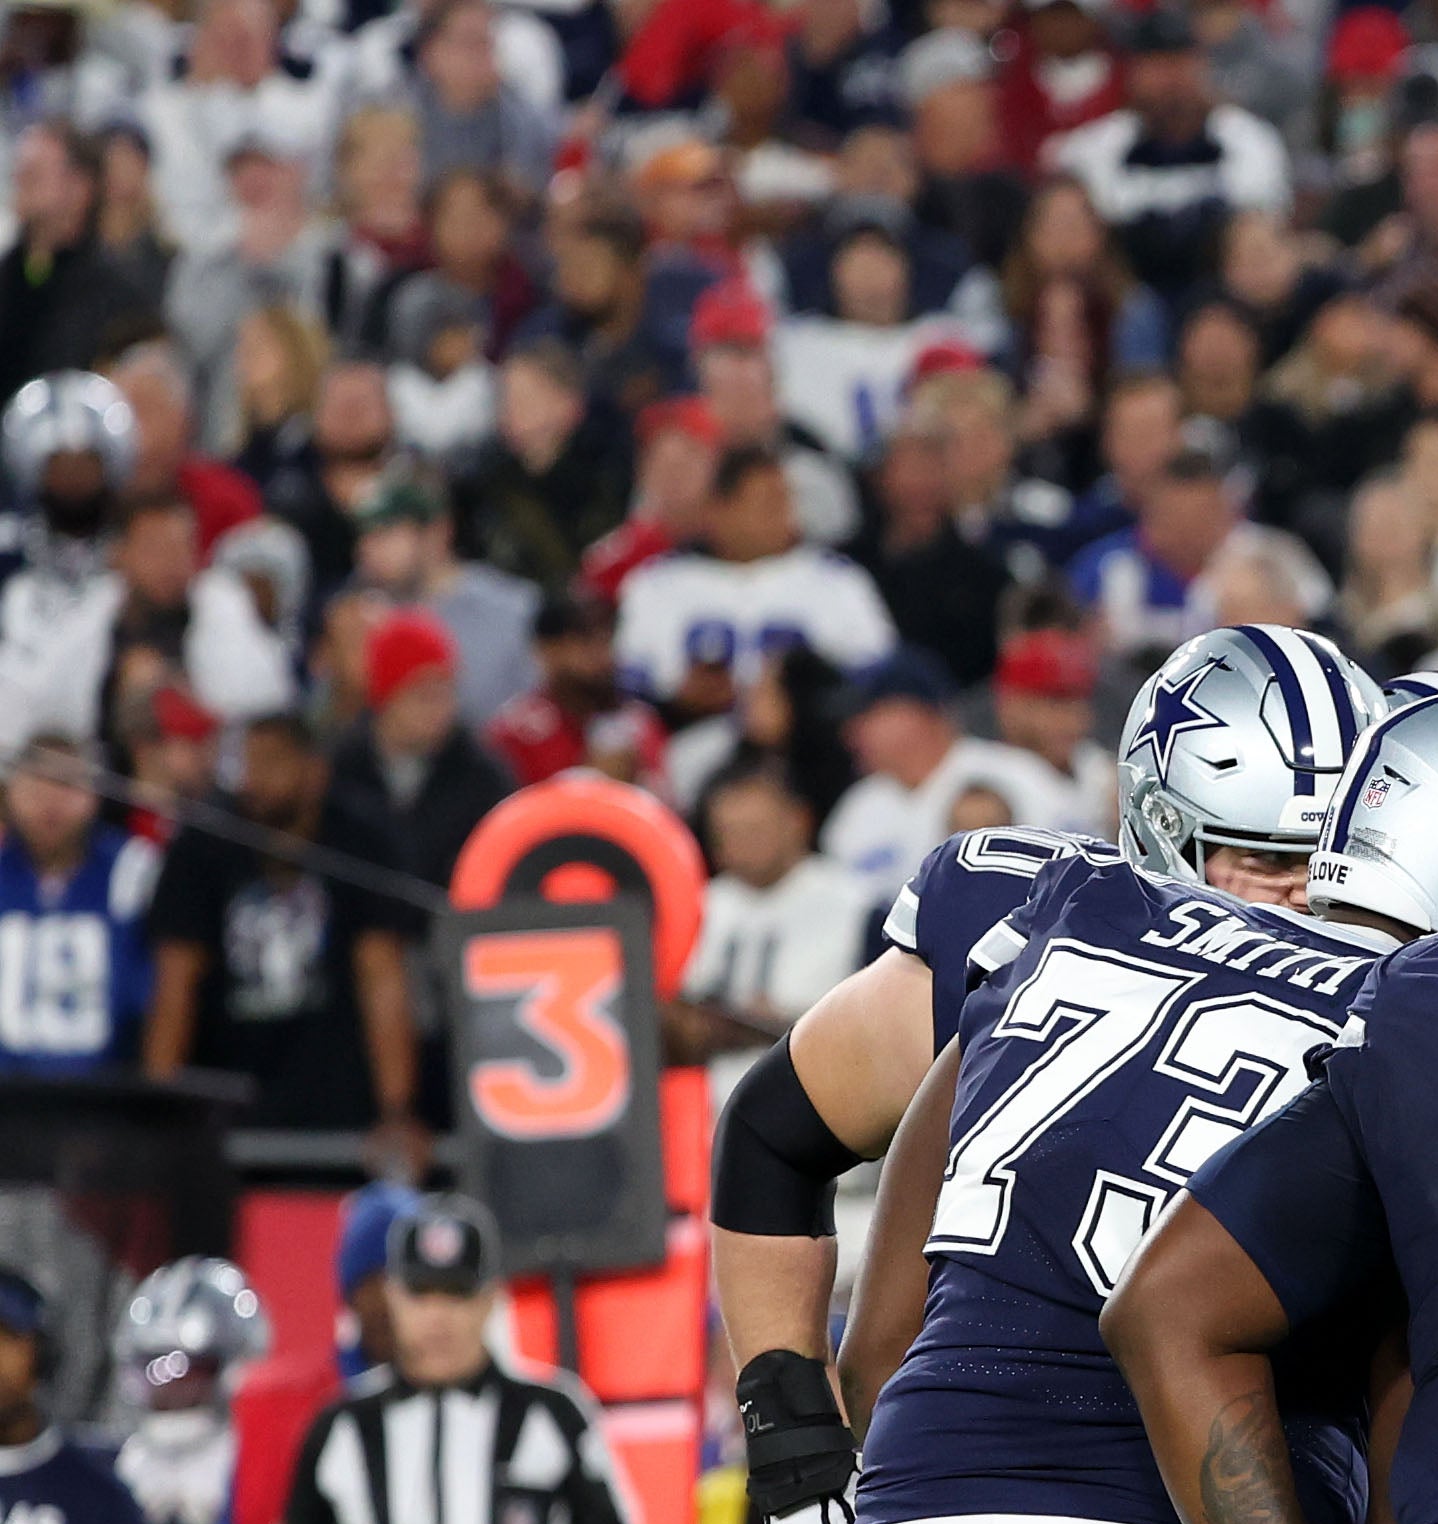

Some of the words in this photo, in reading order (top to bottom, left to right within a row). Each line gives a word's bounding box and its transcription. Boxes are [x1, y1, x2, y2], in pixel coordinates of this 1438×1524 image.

[1140, 900, 1377, 997] SMITH
[1313, 861, 1349, 885] LOVE
[462, 925, 632, 1143] 3
[922, 937, 1346, 1299] 73
